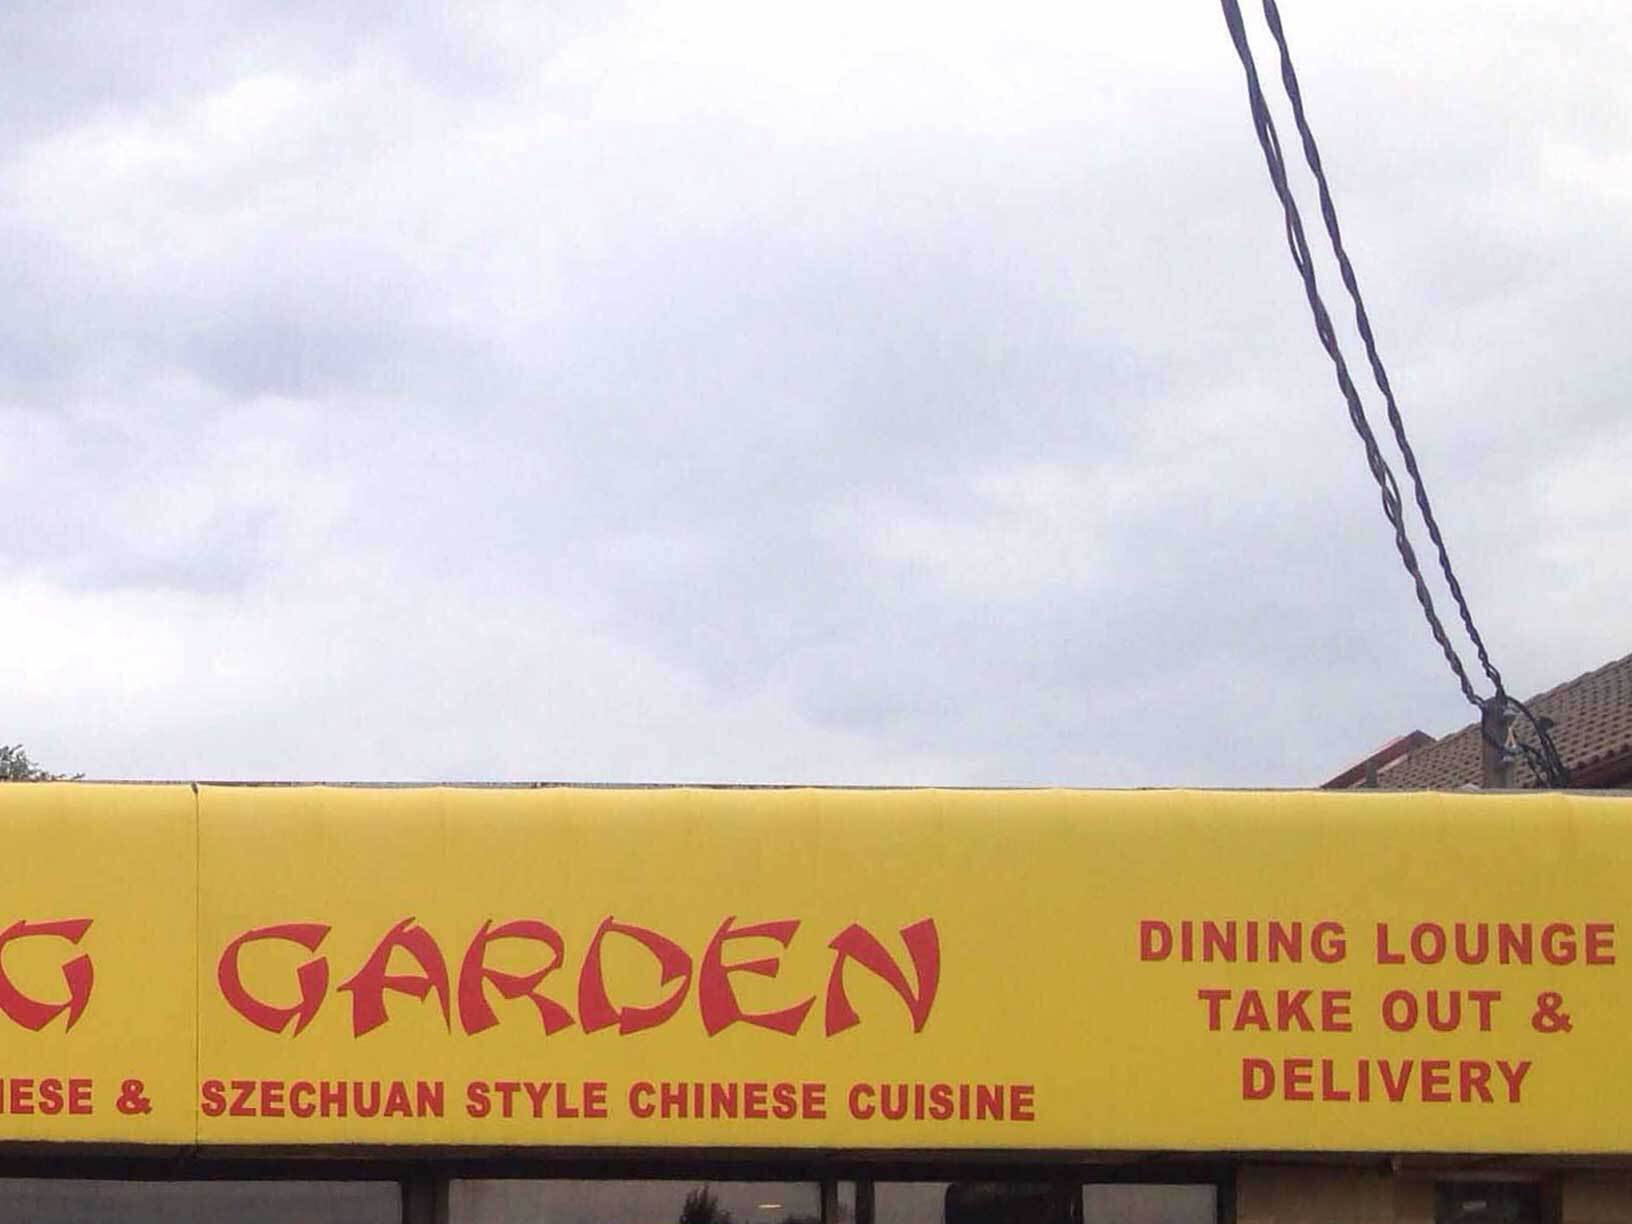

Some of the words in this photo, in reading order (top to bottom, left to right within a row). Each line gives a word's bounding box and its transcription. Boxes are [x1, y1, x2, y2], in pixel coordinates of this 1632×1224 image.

[1137, 918, 1347, 963] DINING
[1375, 921, 1617, 966] LOUNGE
[215, 915, 941, 1036] GARDEN
[1197, 987, 1353, 1033] TAKE
[1381, 989, 1502, 1033] OUT
[1530, 991, 1574, 1034] &
[114, 1078, 153, 1116] &
[199, 1078, 446, 1119] SZECHUAN
[464, 1079, 609, 1120] STYLE
[627, 1080, 828, 1121] CHINESE
[846, 1082, 1036, 1122] CUISINE
[1240, 1056, 1532, 1104] DELIVERY
